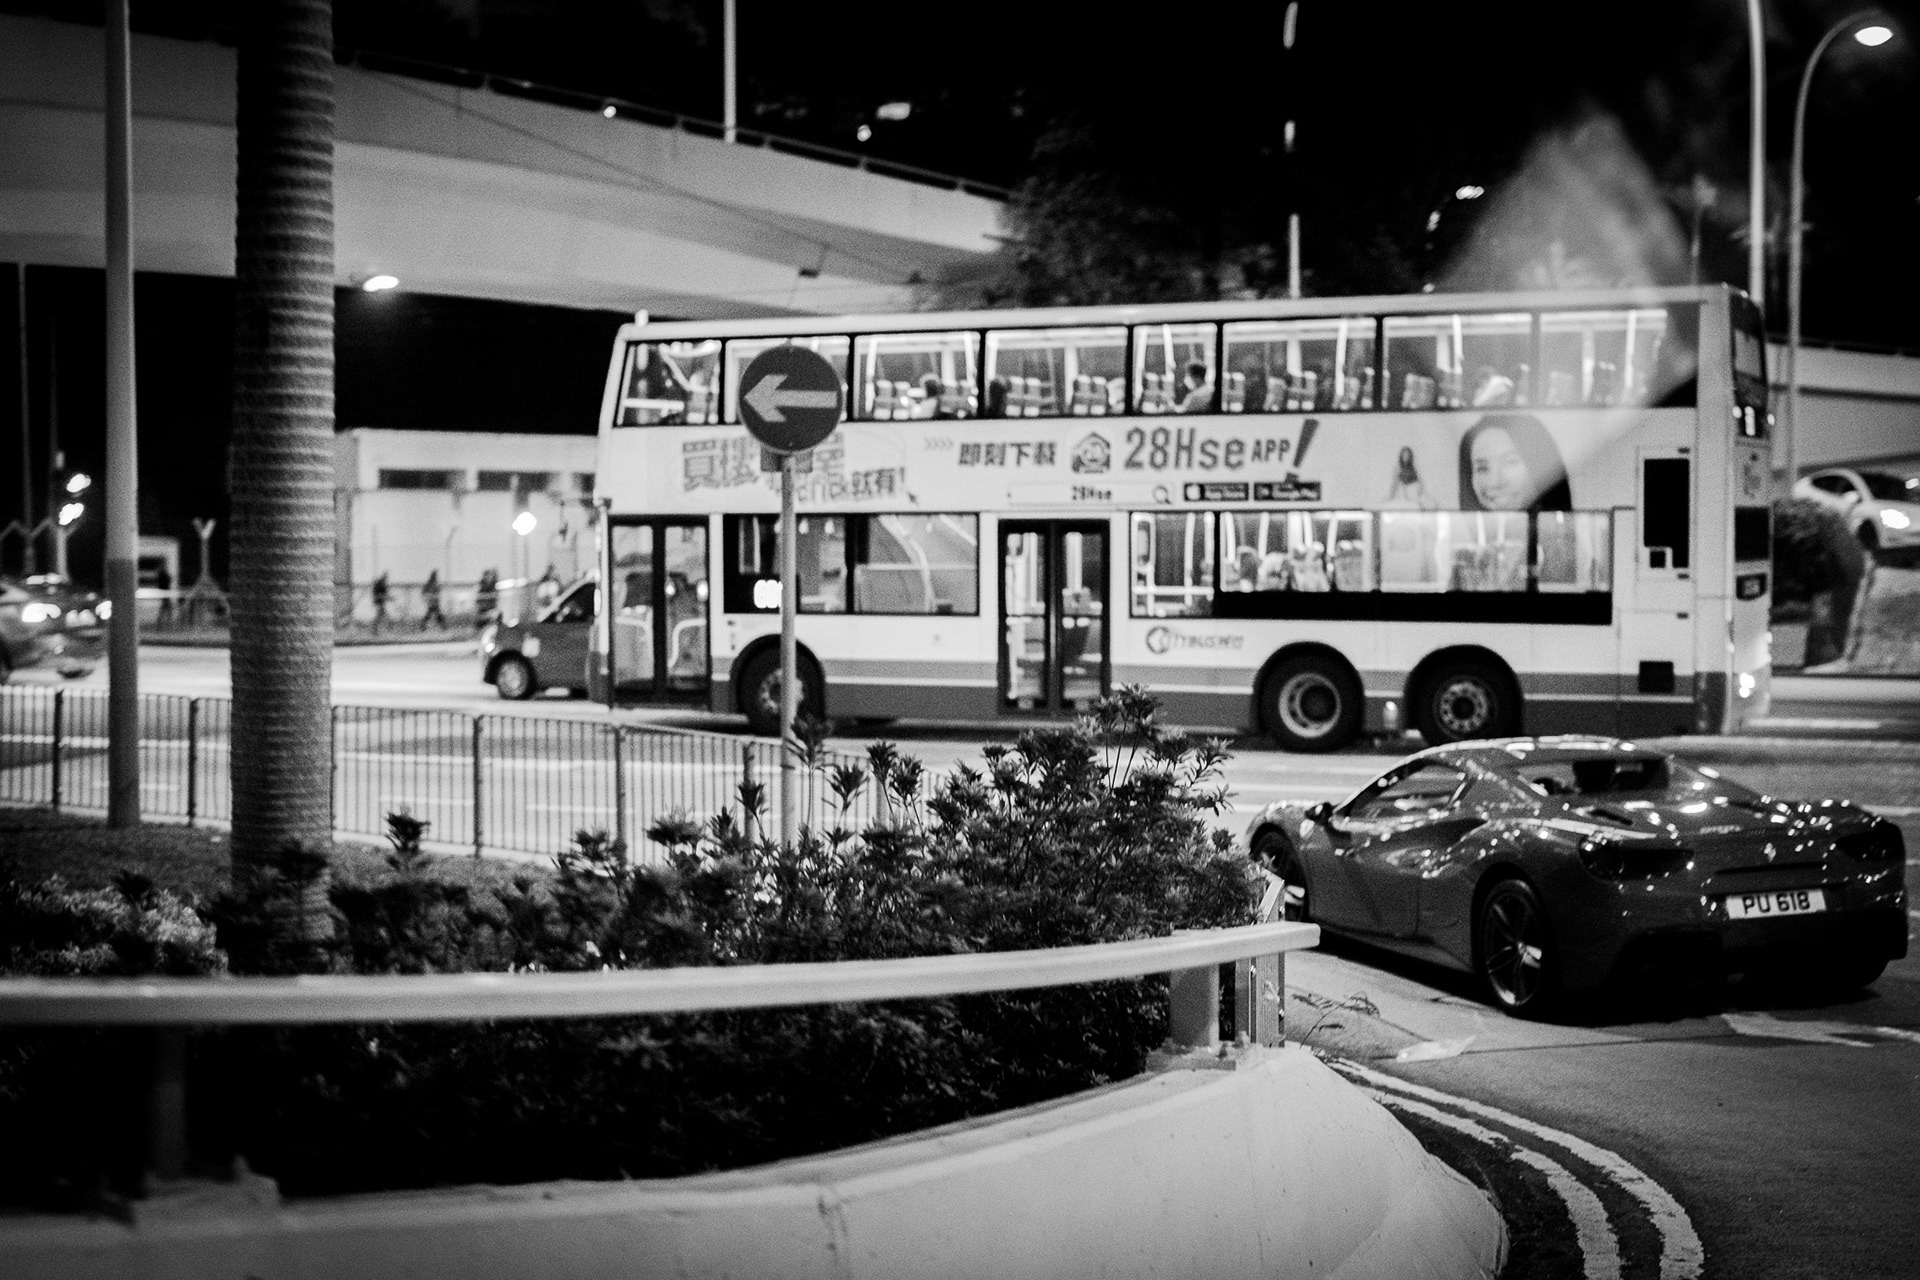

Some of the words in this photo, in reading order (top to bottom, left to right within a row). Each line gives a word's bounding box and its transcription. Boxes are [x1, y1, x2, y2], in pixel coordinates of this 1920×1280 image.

[958, 441, 1057, 467] 即刻下載
[1124, 426, 1246, 470] 28Hse
[1742, 895, 1771, 915] PU
[1776, 891, 1811, 912] 618
